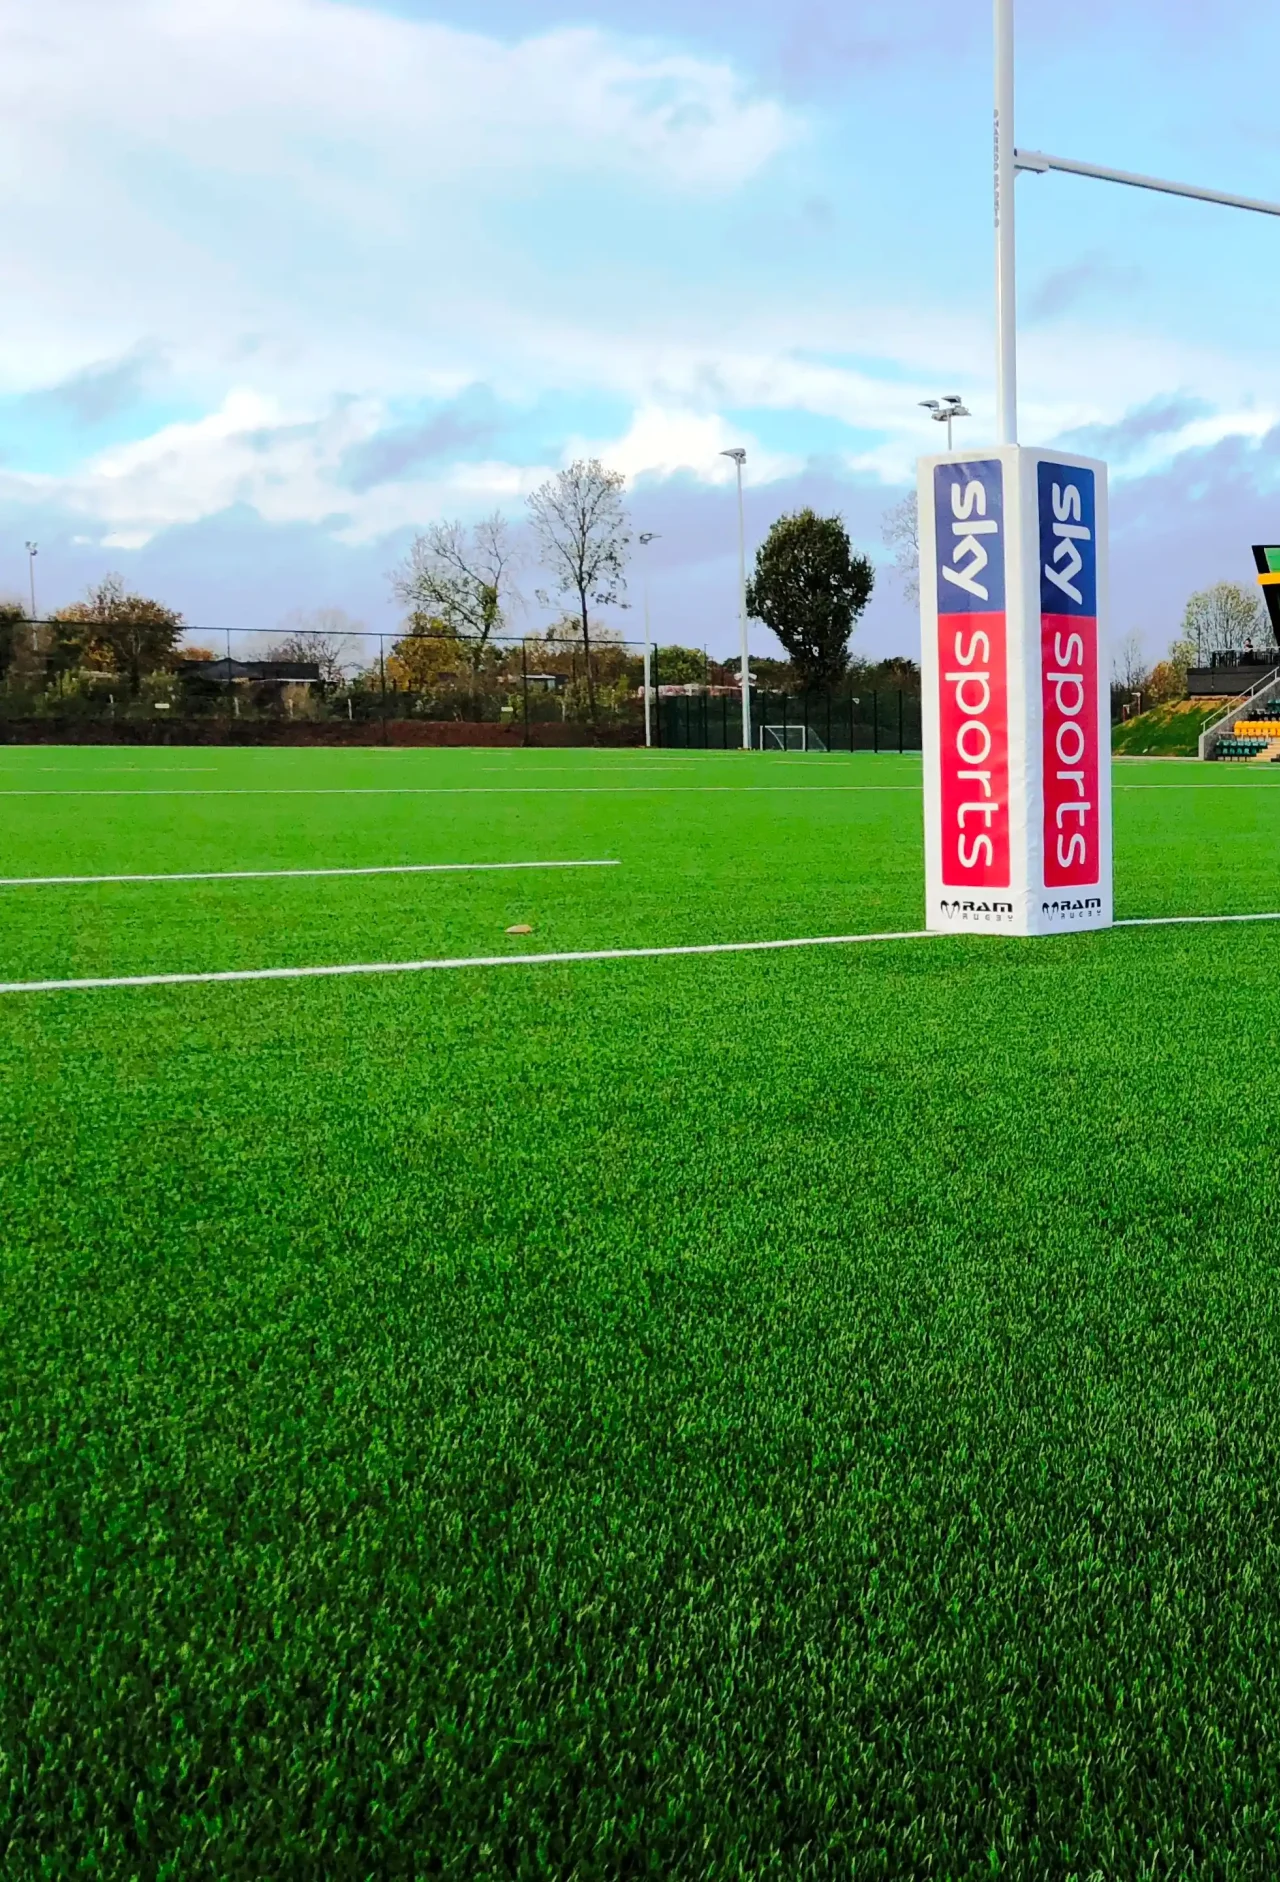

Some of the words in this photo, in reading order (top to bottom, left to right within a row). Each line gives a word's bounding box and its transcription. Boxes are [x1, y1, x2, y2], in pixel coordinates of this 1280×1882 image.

[942, 480, 998, 602] sky
[1045, 483, 1091, 605] sky
[945, 631, 999, 868] sports
[1047, 632, 1092, 868] sports
[963, 901, 1013, 912] RAM
[1061, 898, 1101, 910] RAM
